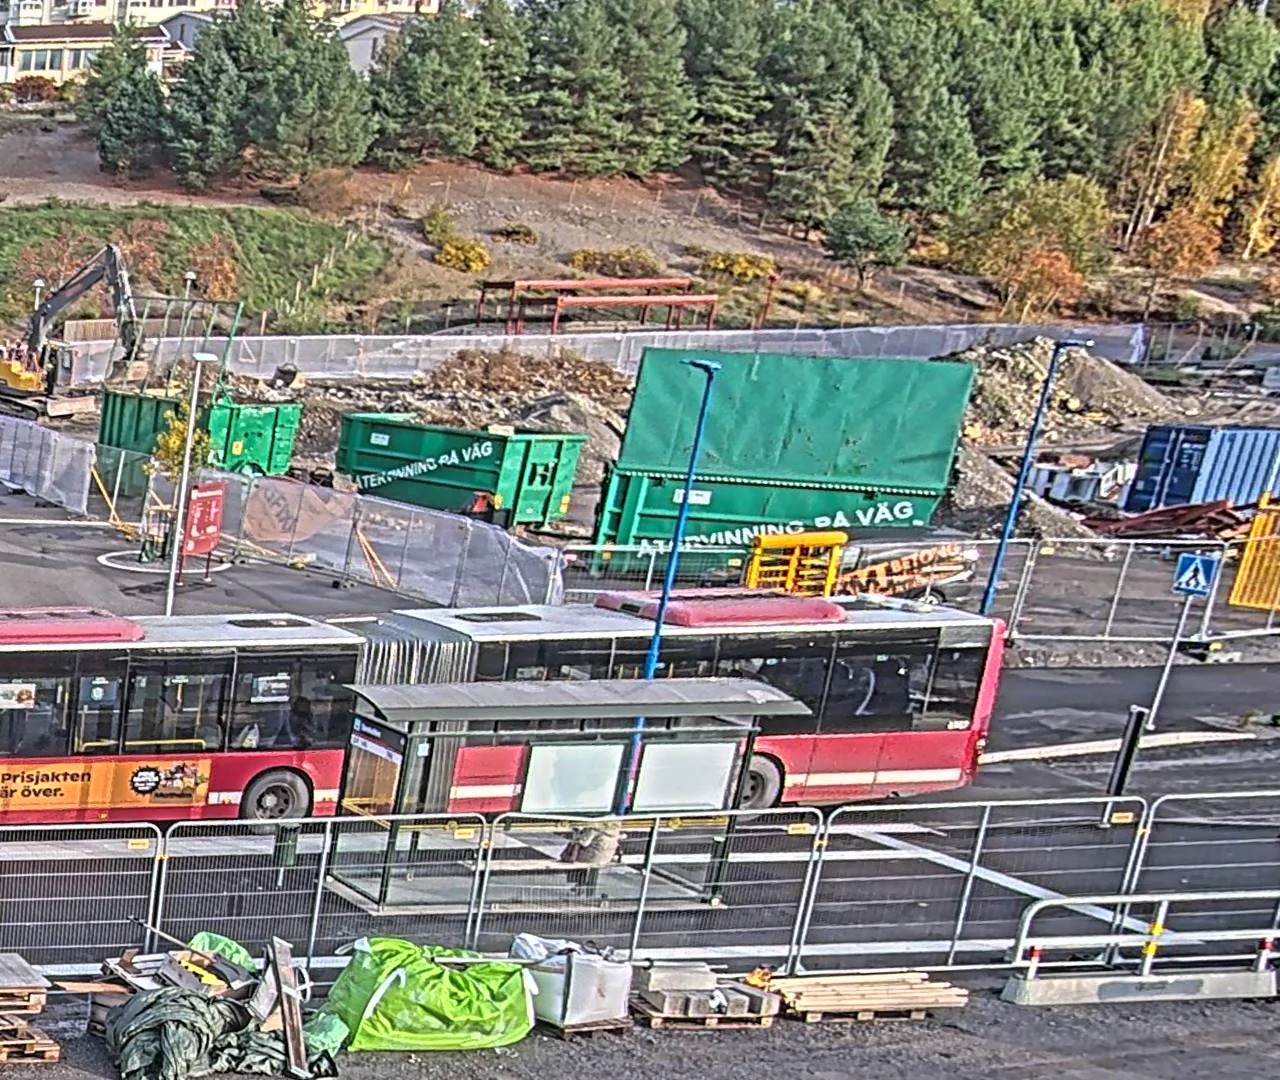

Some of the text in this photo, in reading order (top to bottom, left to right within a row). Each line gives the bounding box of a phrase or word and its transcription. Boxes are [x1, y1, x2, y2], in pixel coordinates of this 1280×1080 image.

[461, 441, 493, 461] VÄG
[855, 500, 914, 527] VÄG
[0, 770, 91, 784] Prisjakten
[0, 785, 65, 799] är över.
